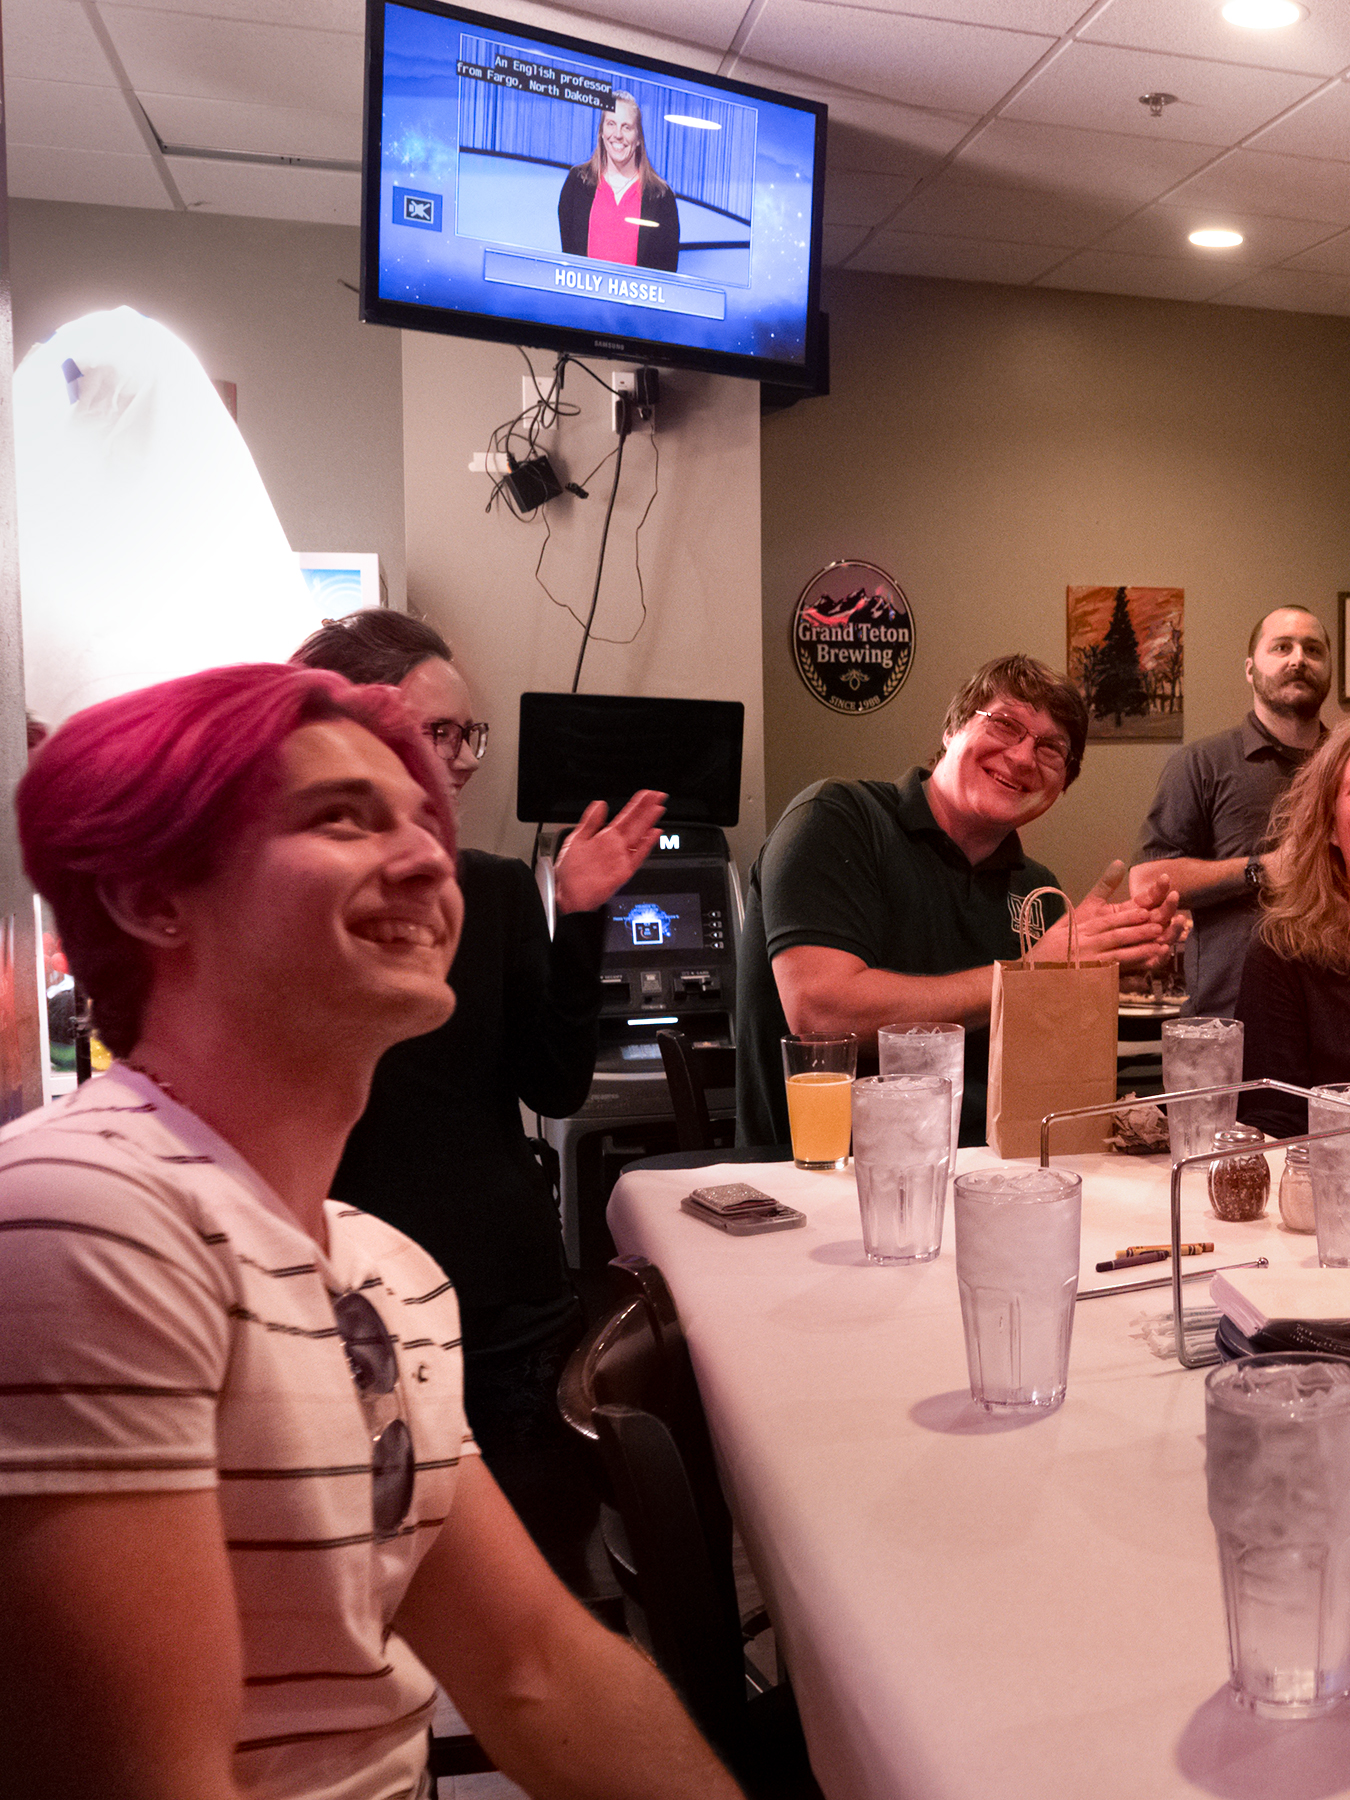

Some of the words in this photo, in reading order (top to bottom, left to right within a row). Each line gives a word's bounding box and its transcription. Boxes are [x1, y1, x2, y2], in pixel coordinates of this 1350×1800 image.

[456, 61, 483, 77] from
[486, 69, 523, 89] Fargo,
[529, 79, 560, 96] North
[564, 88, 615, 110] Dakota...
[495, 56, 508, 68] An
[513, 60, 556, 80] English
[560, 73, 612, 94] professor
[555, 268, 603, 292] HOLLY
[608, 278, 666, 304] HASSEL
[594, 340, 625, 350] SAMSUNG
[798, 622, 855, 642] Grand
[858, 622, 910, 643] Teton
[816, 643, 894, 669] Brewing
[829, 695, 856, 710] SINCE
